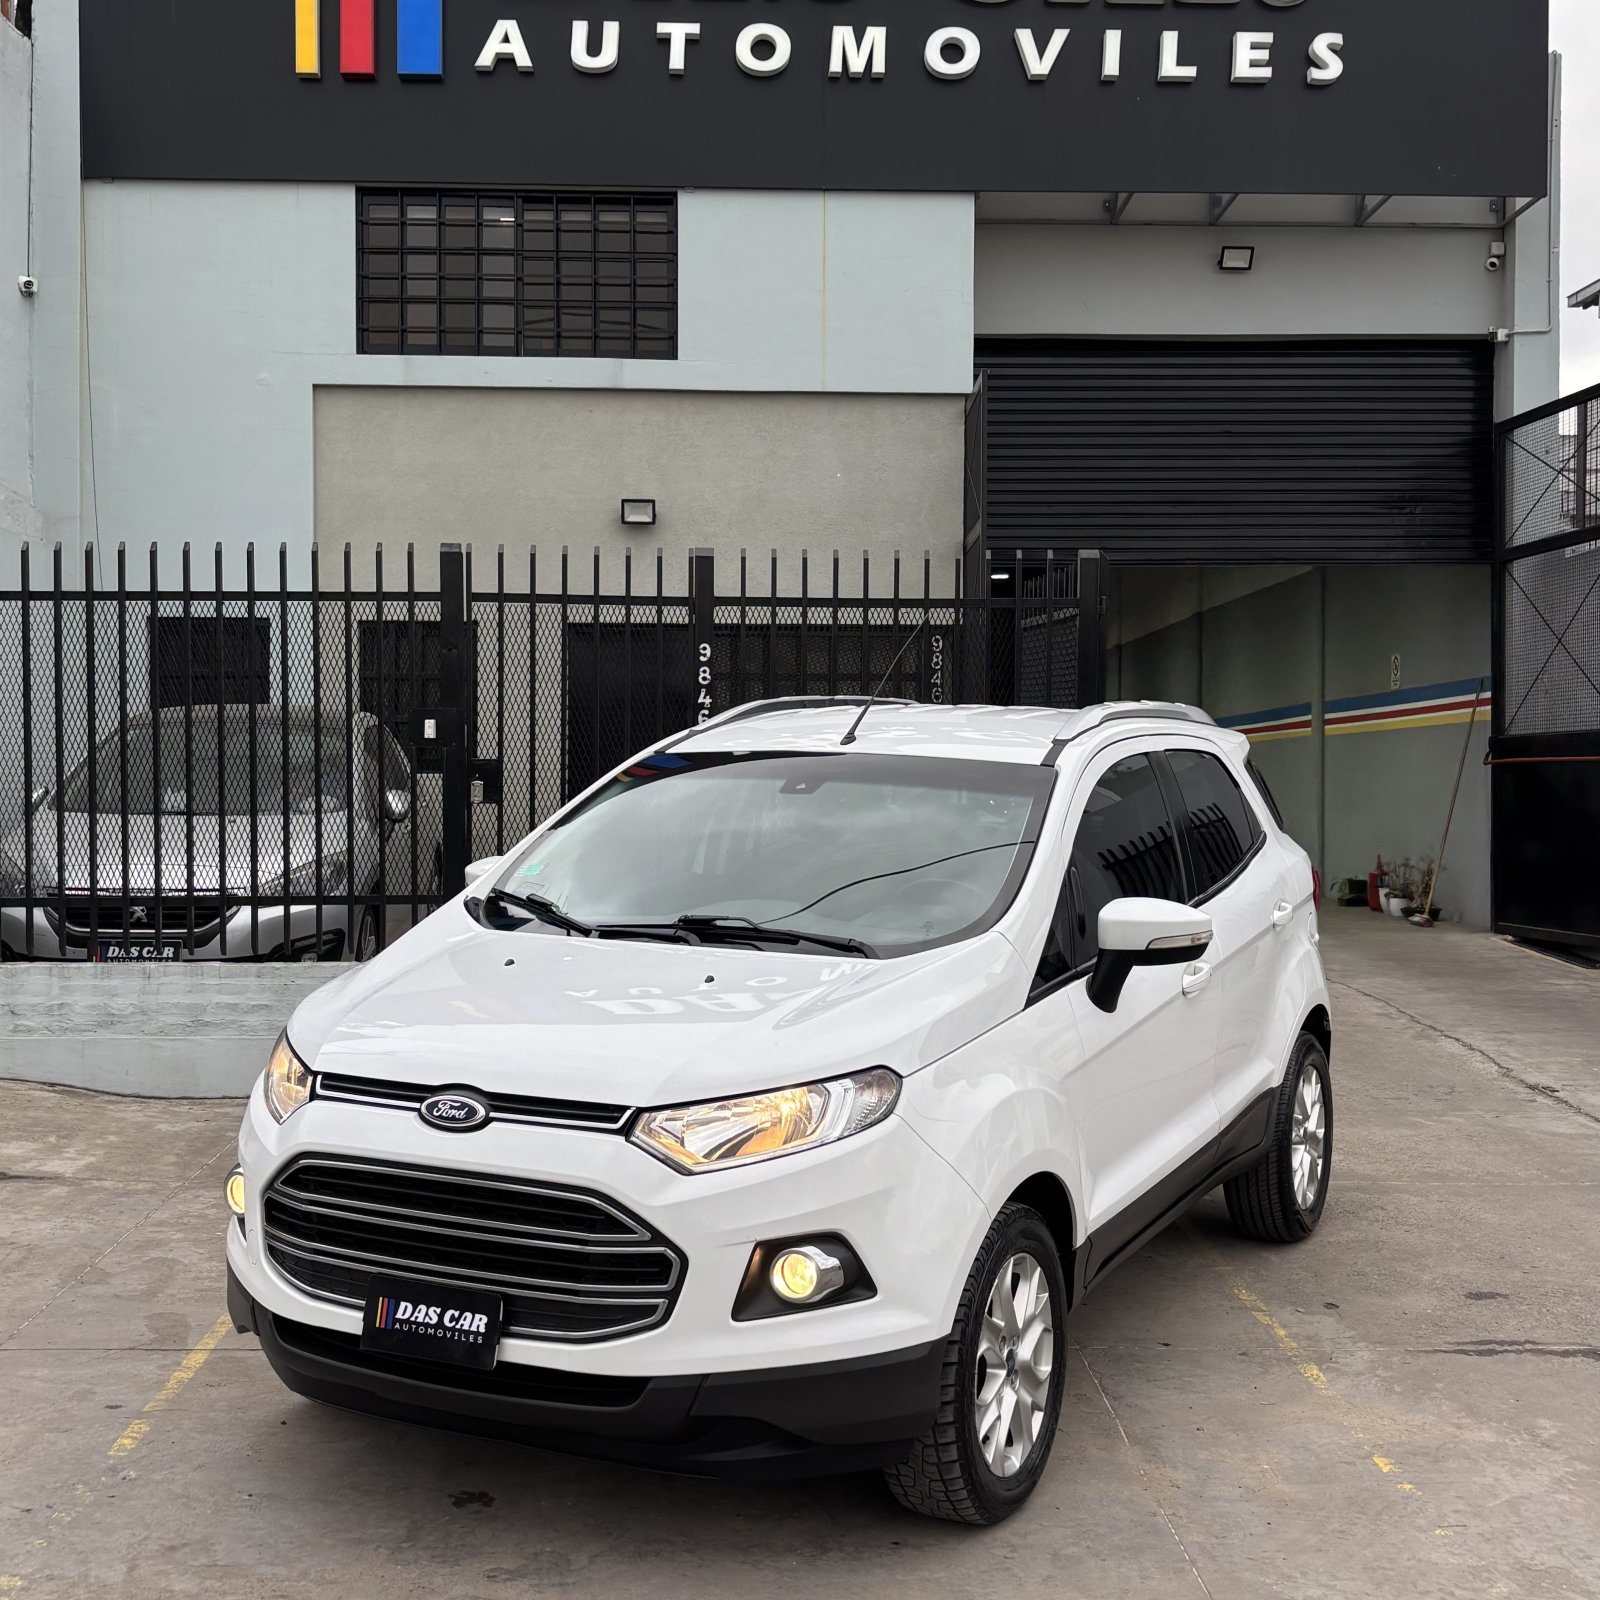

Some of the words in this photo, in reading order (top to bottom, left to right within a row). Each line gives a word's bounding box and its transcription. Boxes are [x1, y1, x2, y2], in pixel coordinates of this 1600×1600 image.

[474, 19, 1345, 86] AUTOMOVILES
[931, 634, 943, 703] 9846
[432, 1100, 469, 1119] Ford
[394, 1322, 483, 1344] AUTOMOVILES
[395, 1301, 441, 1325] DAS
[443, 1309, 488, 1333] CAR
